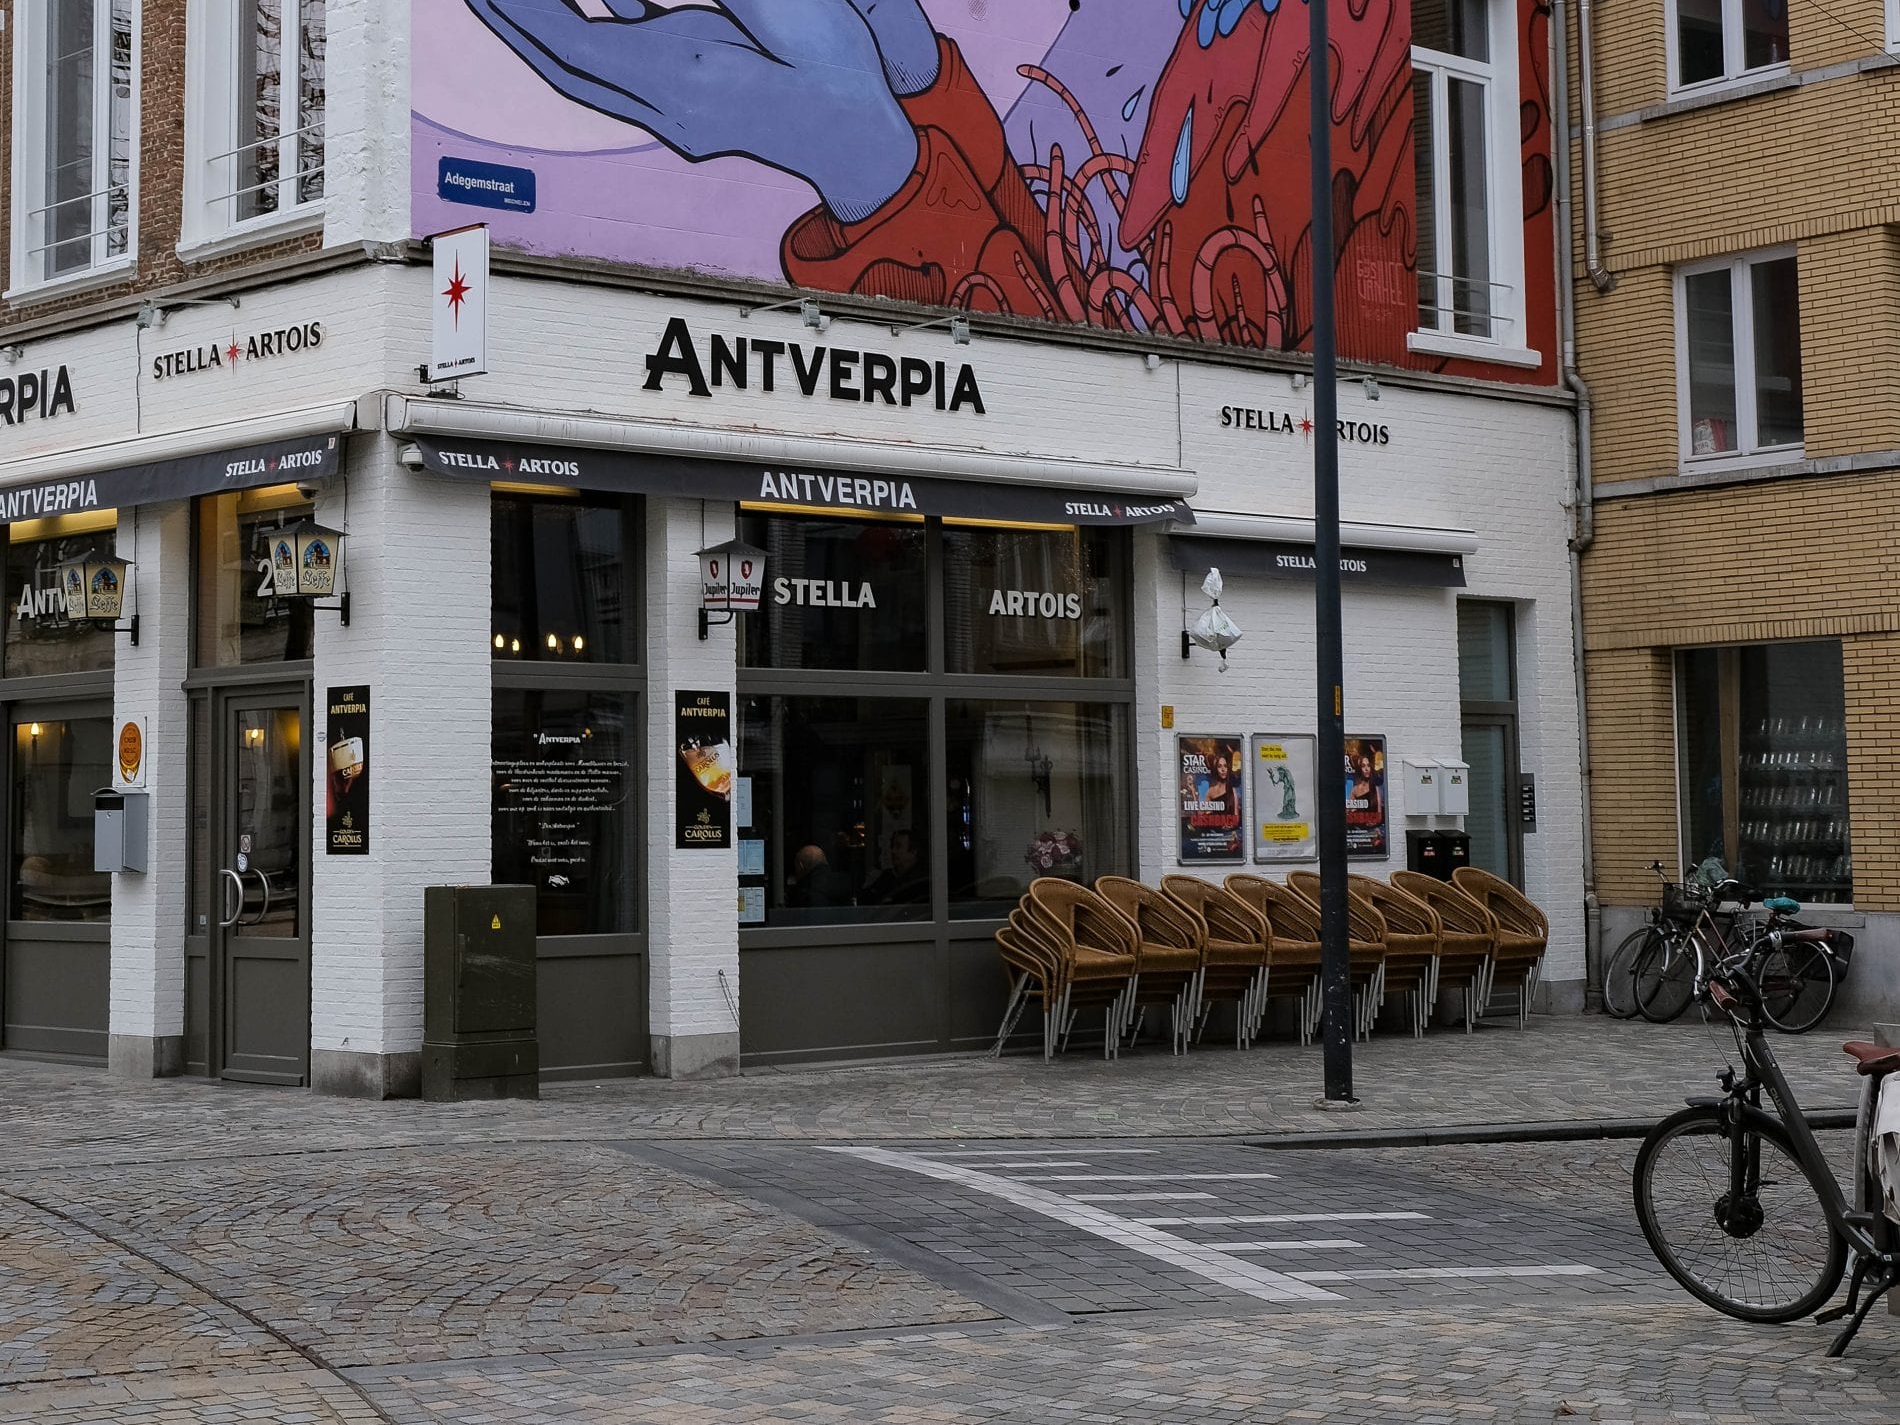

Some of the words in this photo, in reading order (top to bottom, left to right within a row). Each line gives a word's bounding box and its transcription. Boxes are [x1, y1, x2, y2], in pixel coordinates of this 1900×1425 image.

[444, 171, 514, 193] Adegemstraat
[153, 343, 221, 380] STELLA
[246, 322, 321, 361] ARTOIS
[437, 361, 454, 370] STELLA
[642, 317, 986, 415] ANTVERPIA
[1221, 405, 1295, 434] STELLA
[1337, 420, 1390, 446] RTOIS
[225, 458, 266, 478] STELLA
[278, 449, 323, 471] ARTOIS
[439, 451, 500, 470] STELLA
[519, 458, 580, 476] ARTOIS
[760, 472, 917, 509] ANTVERPIA
[1065, 502, 1112, 517] STELLA
[1126, 504, 1175, 517] ARTOIS
[1276, 554, 1316, 569] STELLA
[301, 569, 331, 589] Leffe
[704, 582, 728, 597] Jupiler
[731, 582, 761, 598] Jupiler
[773, 577, 877, 609] STELLA
[89, 594, 119, 613] Leffe
[988, 589, 1081, 619] ARTOIS
[342, 691, 355, 703] CAFÉ
[696, 697, 711, 706] CAFÉ
[330, 703, 367, 715] ANTVERPIA
[681, 707, 727, 718] ANTVERPIA
[1183, 755, 1206, 767] STAR
[1183, 801, 1199, 811] LIVE
[1200, 801, 1225, 811] CASINO
[1345, 799, 1369, 809] CASINO
[332, 834, 362, 846] CAROLUS
[684, 829, 723, 842] CAROLUS
